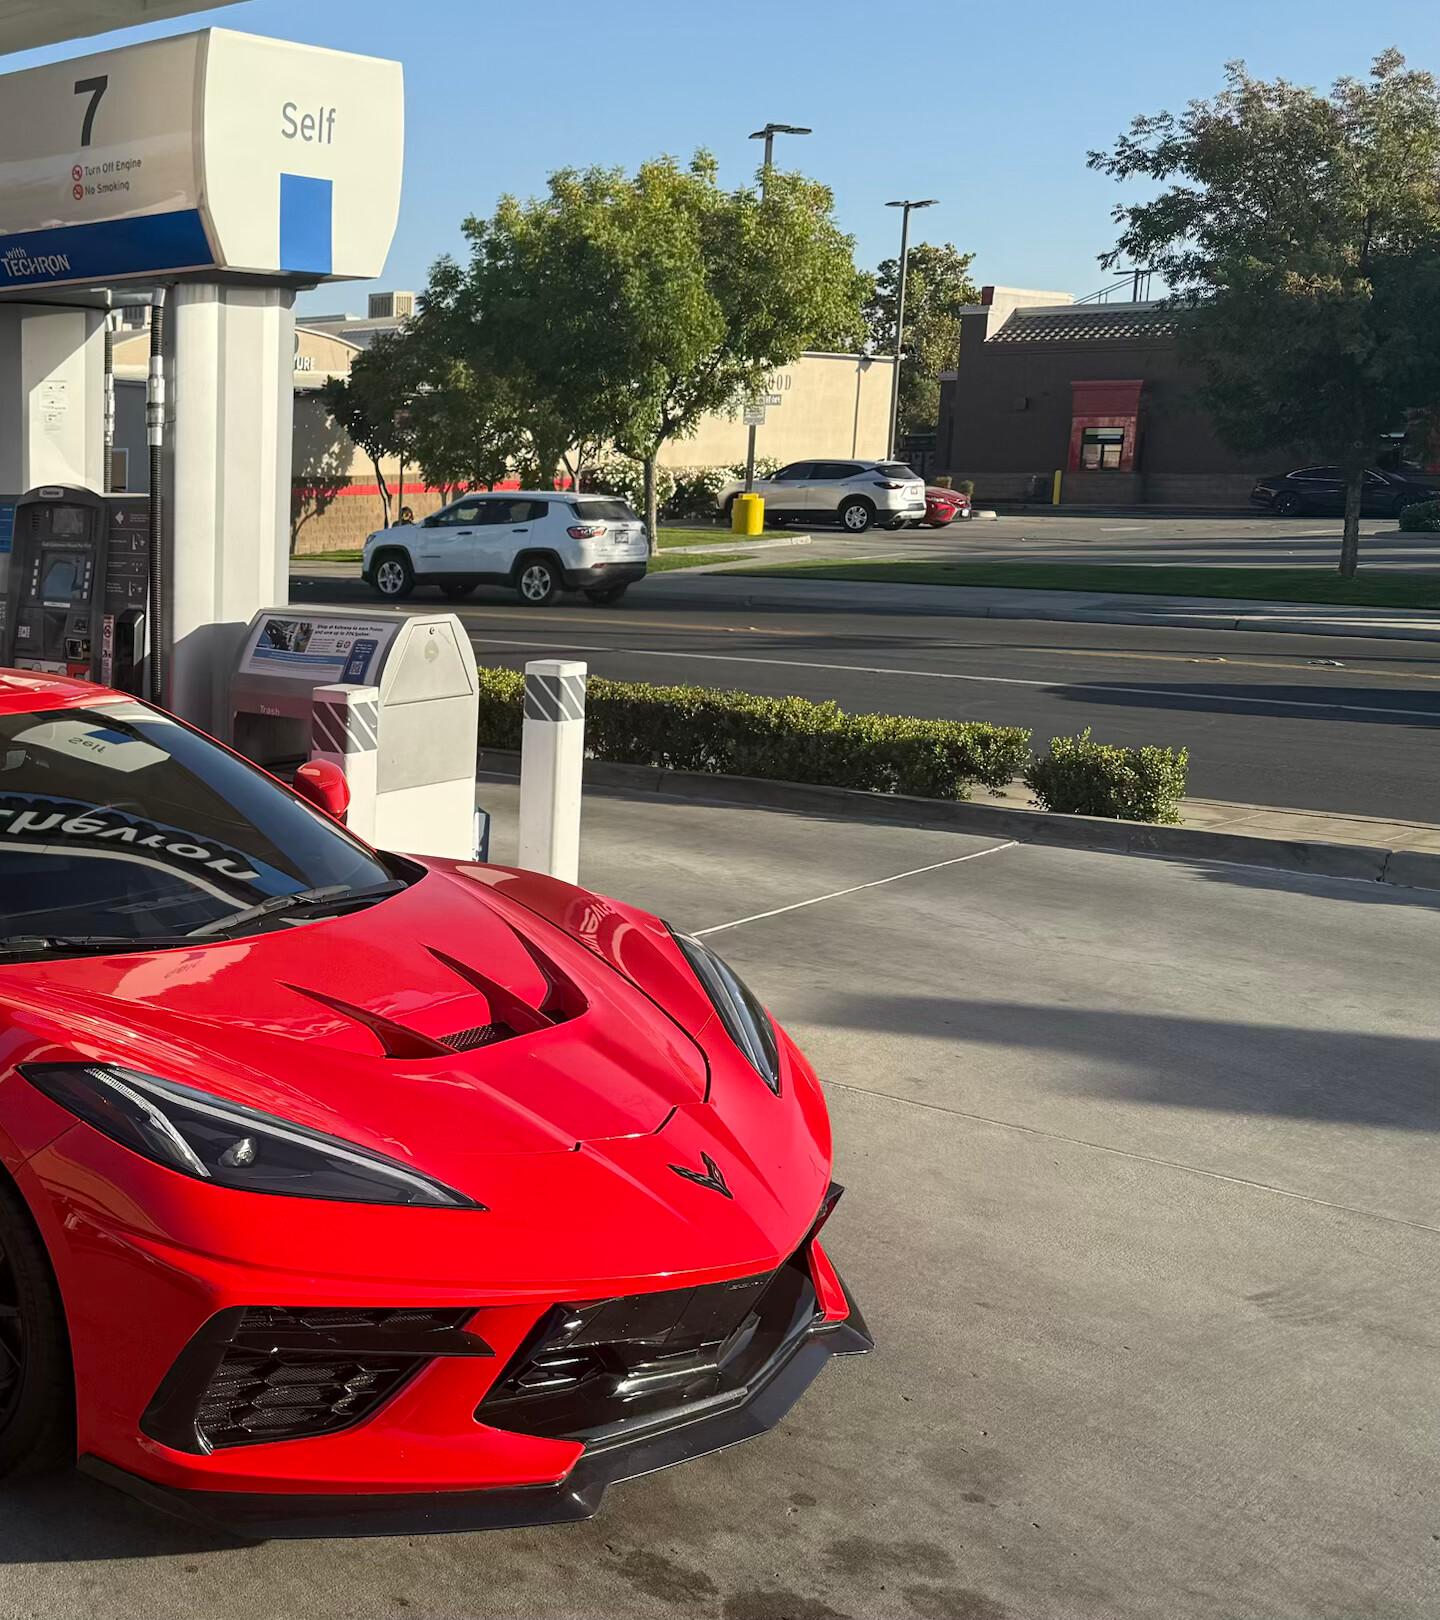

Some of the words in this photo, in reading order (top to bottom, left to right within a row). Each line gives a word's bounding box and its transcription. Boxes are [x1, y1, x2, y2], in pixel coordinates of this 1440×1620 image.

[74, 75, 108, 147] 7
[280, 101, 337, 145] Self
[84, 166, 101, 177] Turn
[102, 161, 115, 174] Off
[116, 158, 142, 172] Engine
[84, 186, 96, 196] No
[97, 180, 130, 194] Smoking
[6, 247, 27, 259] with
[0, 253, 71, 277] TECHRON
[260, 705, 281, 716] Trash
